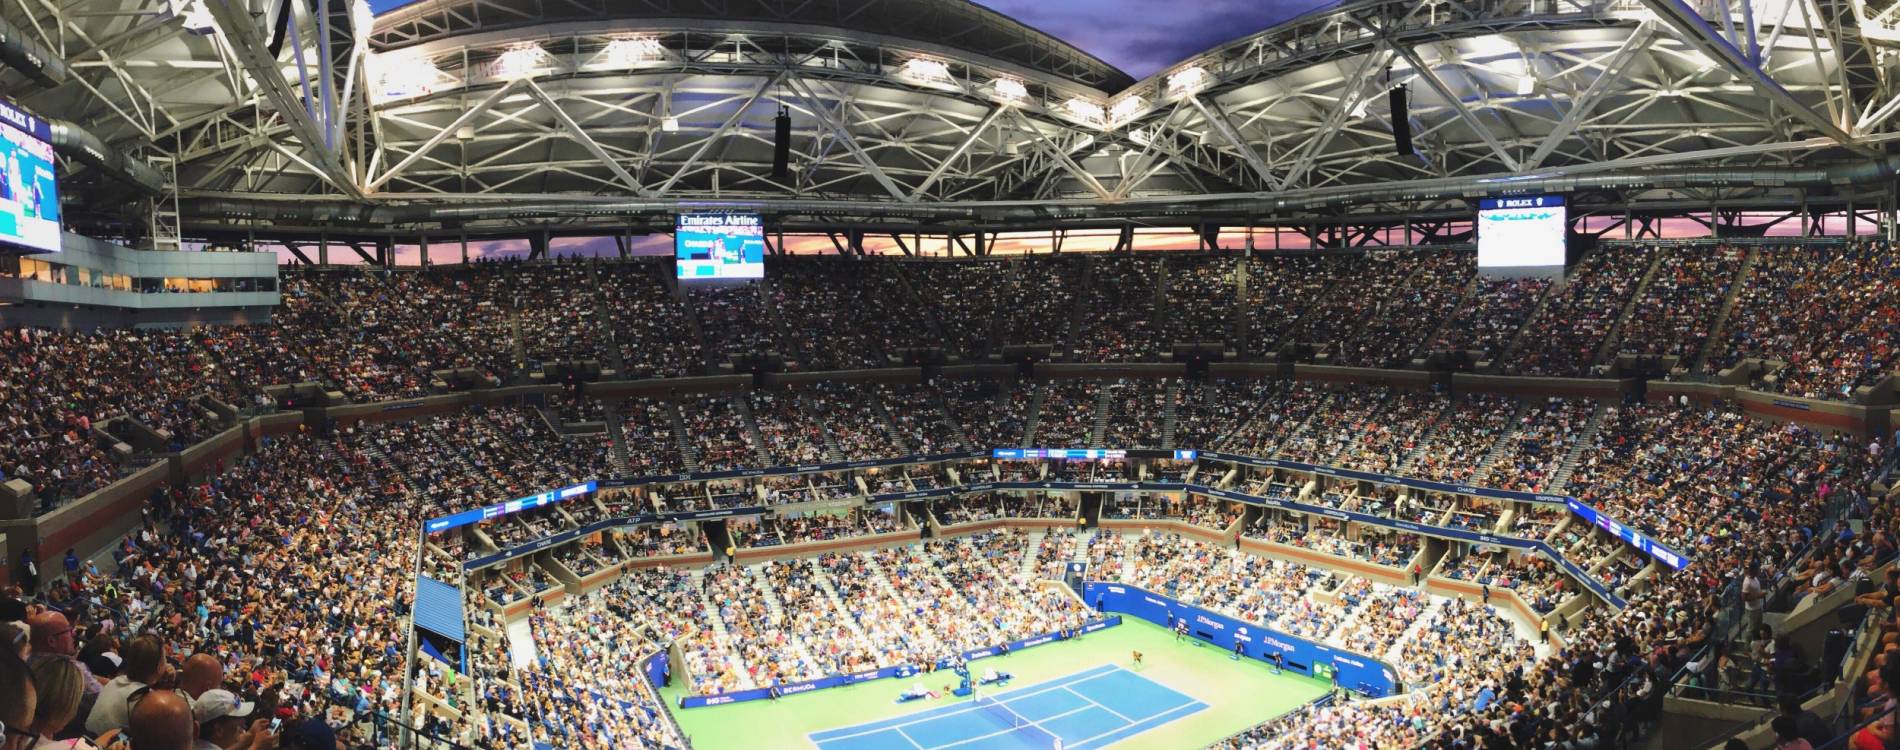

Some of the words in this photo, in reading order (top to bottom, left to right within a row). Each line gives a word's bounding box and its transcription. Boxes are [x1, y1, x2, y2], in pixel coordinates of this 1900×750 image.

[1506, 199, 1533, 207] ROLEX
[681, 215, 722, 226] Emirates
[724, 215, 759, 226] Airline
